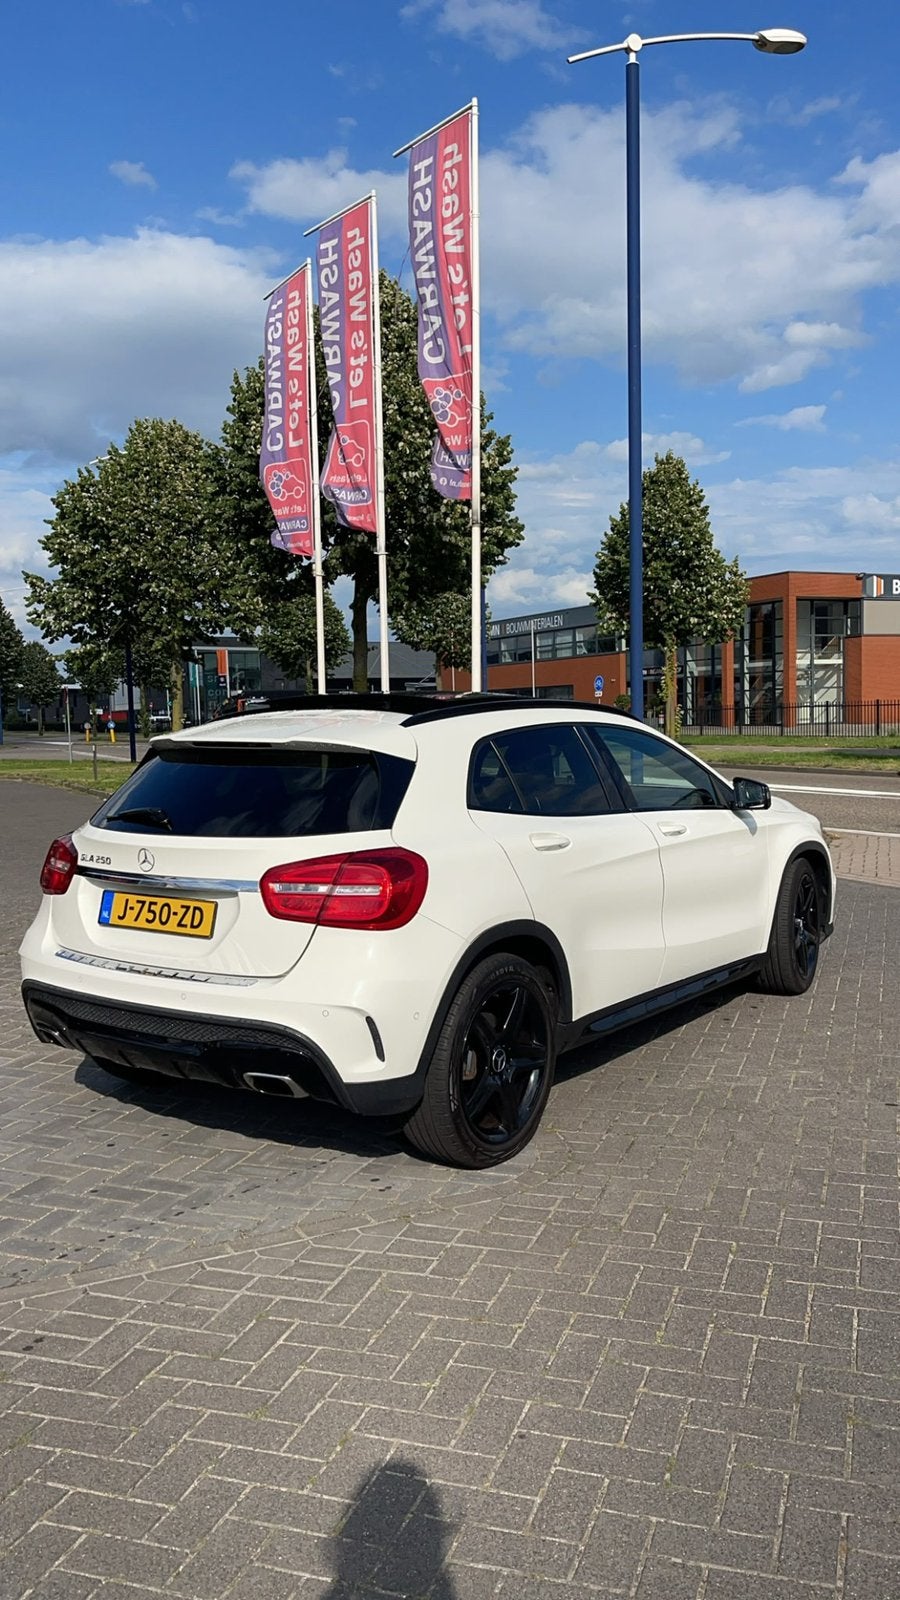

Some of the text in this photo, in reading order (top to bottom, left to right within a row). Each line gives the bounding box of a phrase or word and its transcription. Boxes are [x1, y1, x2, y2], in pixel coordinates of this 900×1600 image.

[505, 614, 564, 634] BOUWMATERIALEN
[95, 855, 112, 866] 250
[117, 898, 204, 930] J-750-ZD
